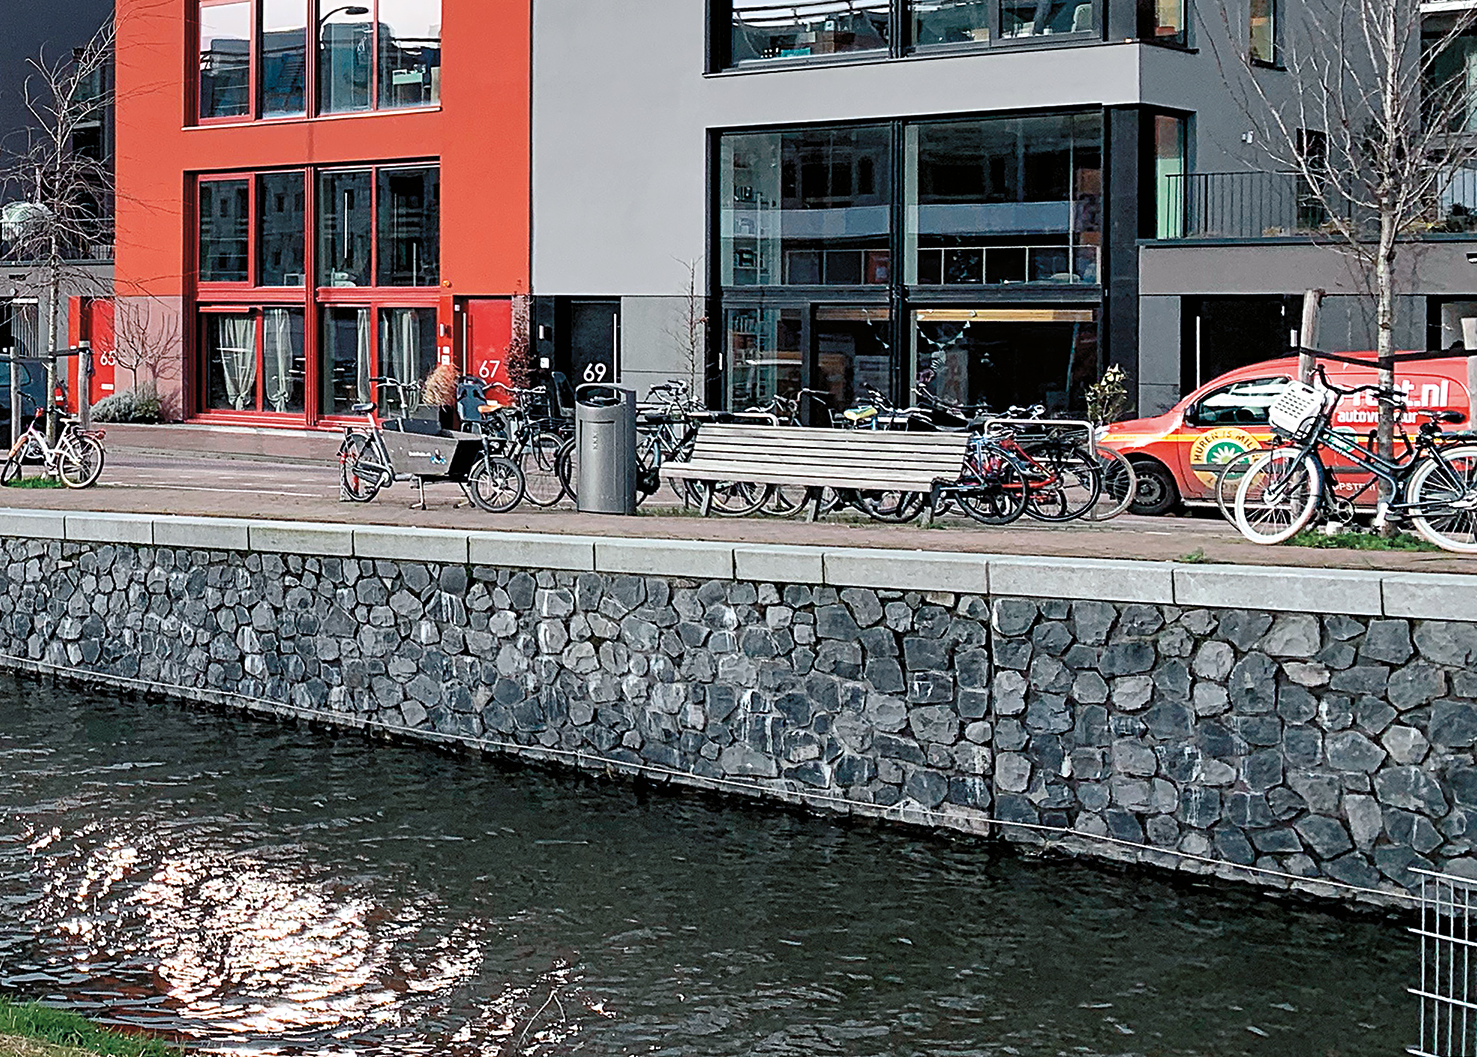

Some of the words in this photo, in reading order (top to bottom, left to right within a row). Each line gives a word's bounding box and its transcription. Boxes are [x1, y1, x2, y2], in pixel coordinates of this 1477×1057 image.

[100, 351, 116, 366] 65
[479, 360, 501, 378] 67
[583, 362, 607, 382] 69
[1194, 431, 1219, 461] HUREN
[1222, 430, 1232, 438] IS
